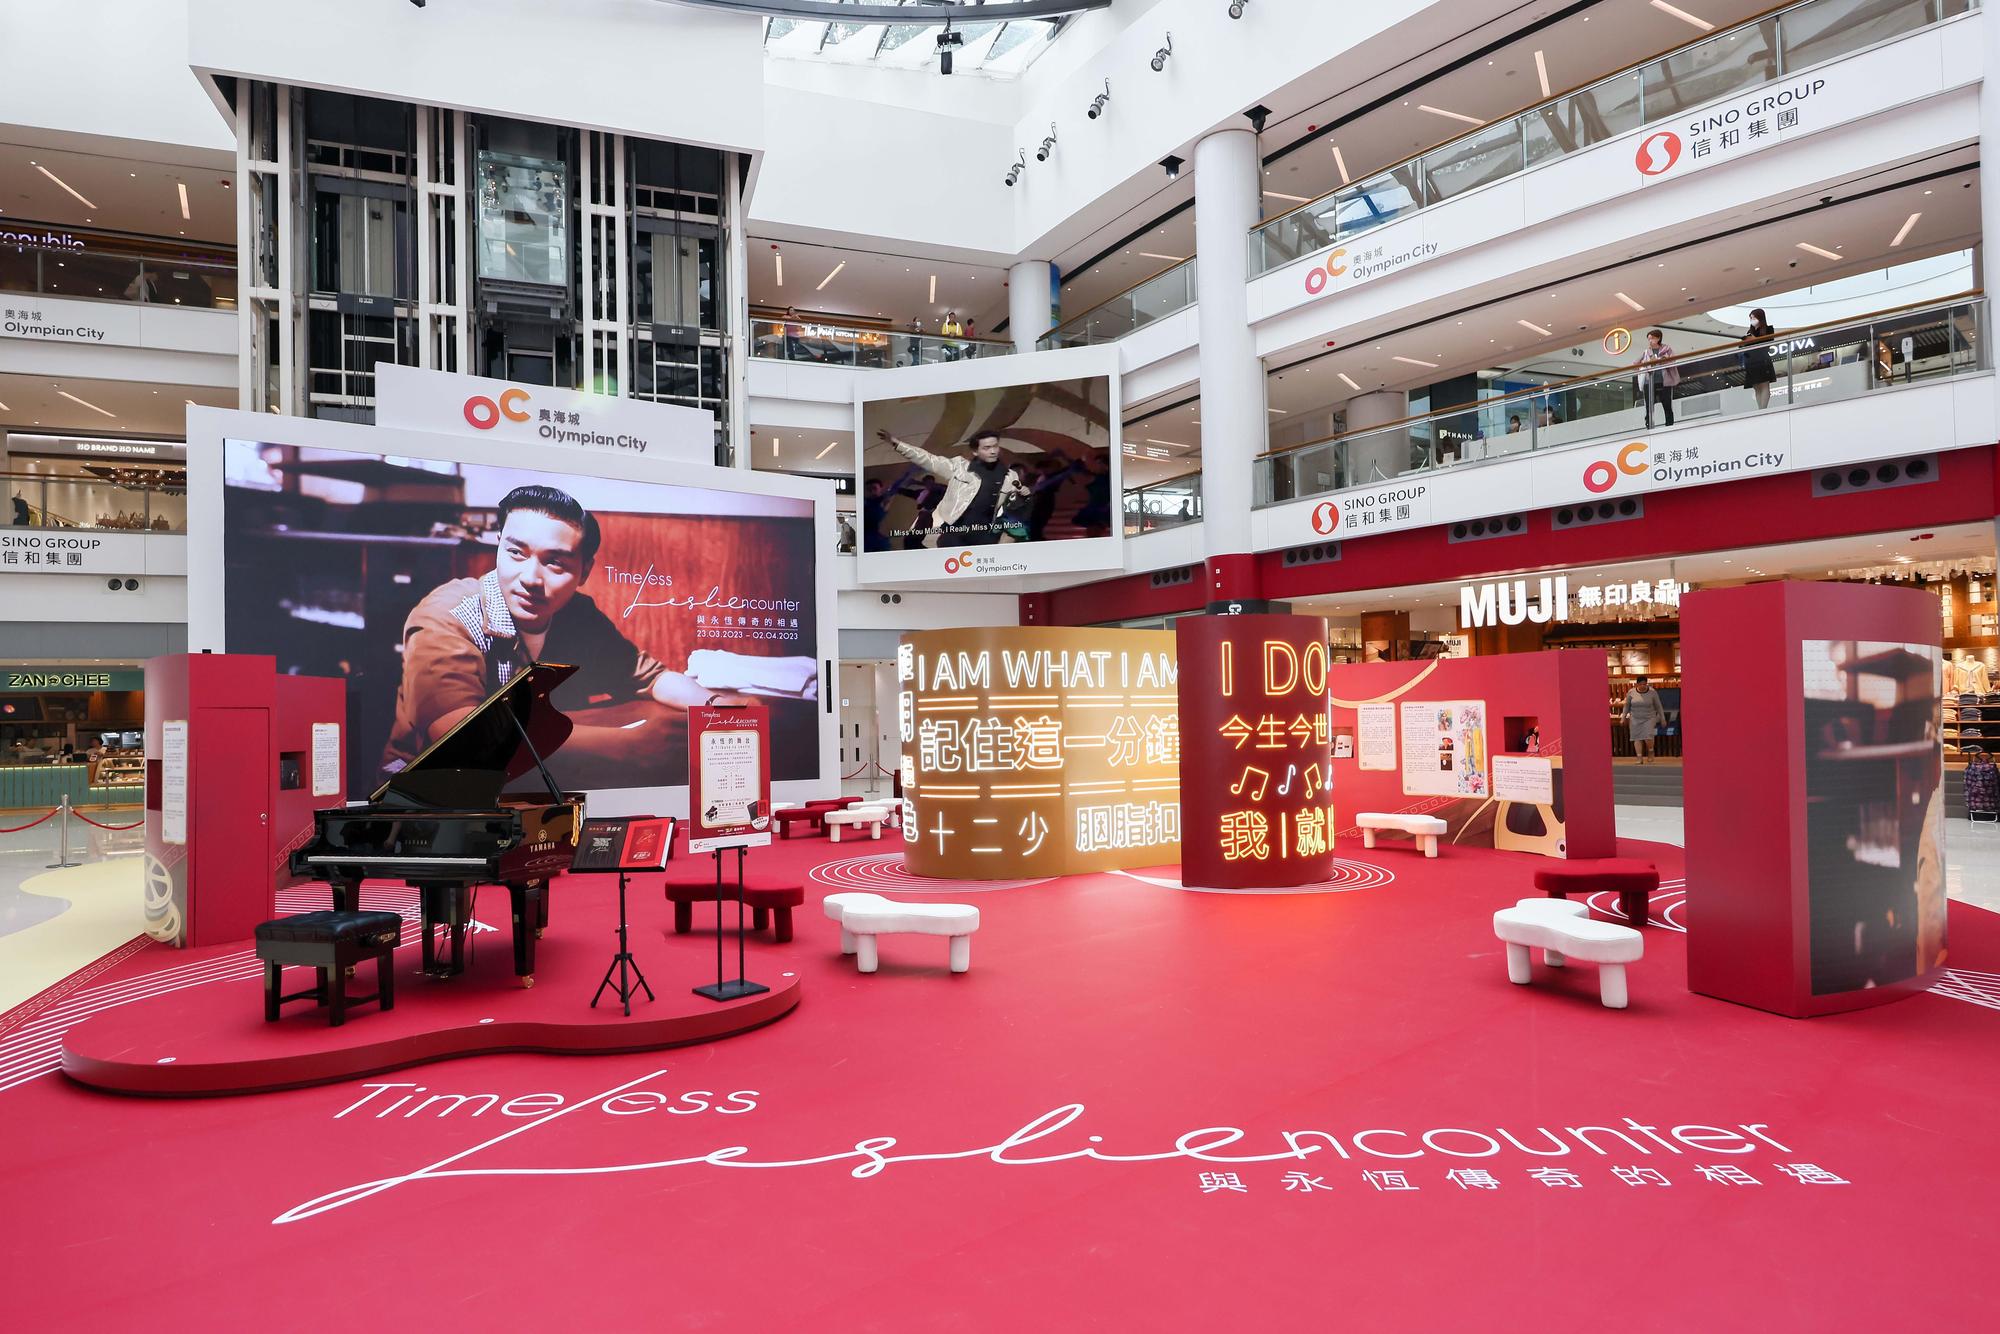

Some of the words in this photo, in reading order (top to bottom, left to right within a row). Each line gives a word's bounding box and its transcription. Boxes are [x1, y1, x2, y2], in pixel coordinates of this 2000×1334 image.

[1690, 109, 1740, 137] SINO
[1746, 79, 1825, 116] GROUP
[1690, 107, 1799, 159] 信和集團
[1353, 246, 1383, 265] 奧海城
[1353, 252, 1411, 280] Olympian
[1412, 241, 1438, 258] City
[4, 308, 42, 322] 奧海城
[4, 321, 74, 337] Olympian
[77, 326, 105, 340] City
[1768, 338, 1815, 357] ODIVA
[539, 409, 580, 426] 奧海城
[538, 425, 614, 446] Olympian
[617, 435, 647, 452] City
[1653, 446, 1700, 466] 奧海城
[1653, 459, 1741, 482] Olympian
[1744, 452, 1784, 469] City
[1344, 496, 1375, 510] SINO
[1378, 486, 1426, 504] GROUP
[1345, 504, 1410, 528] 信和集團
[924, 527, 945, 536] Much,
[949, 525, 970, 534] Really
[971, 523, 988, 531] Miss
[989, 522, 1002, 530] You
[1003, 521, 1023, 529] Much
[1, 536, 41, 548] SINO
[45, 537, 101, 550] GROUP
[2, 550, 82, 566] 信和集團
[976, 565, 1011, 574] Olympian
[1012, 563, 1028, 572] City
[605, 564, 673, 586] Timeless
[1460, 575, 1568, 628] MUJI
[1578, 579, 1680, 607] 無印良品
[697, 630, 743, 639] 23.03.2023
[752, 632, 799, 640] 02.04.2023
[9, 674, 47, 687] ZAN
[61, 674, 110, 687] CHEE
[918, 654, 925, 691] I
[933, 652, 990, 691] AM
[1002, 650, 1111, 688] WHAT
[1121, 652, 1128, 688] I
[1137, 652, 1178, 688] AM
[1264, 641, 1326, 696] DO
[1219, 713, 1328, 749] 今生今世
[919, 715, 1180, 772] 記住這一分鐘
[930, 811, 1049, 856] 十二少
[1076, 802, 1181, 852] 胭脂扣
[530, 842, 555, 852] YAMAHA
[334, 1070, 760, 1118] Timeless
